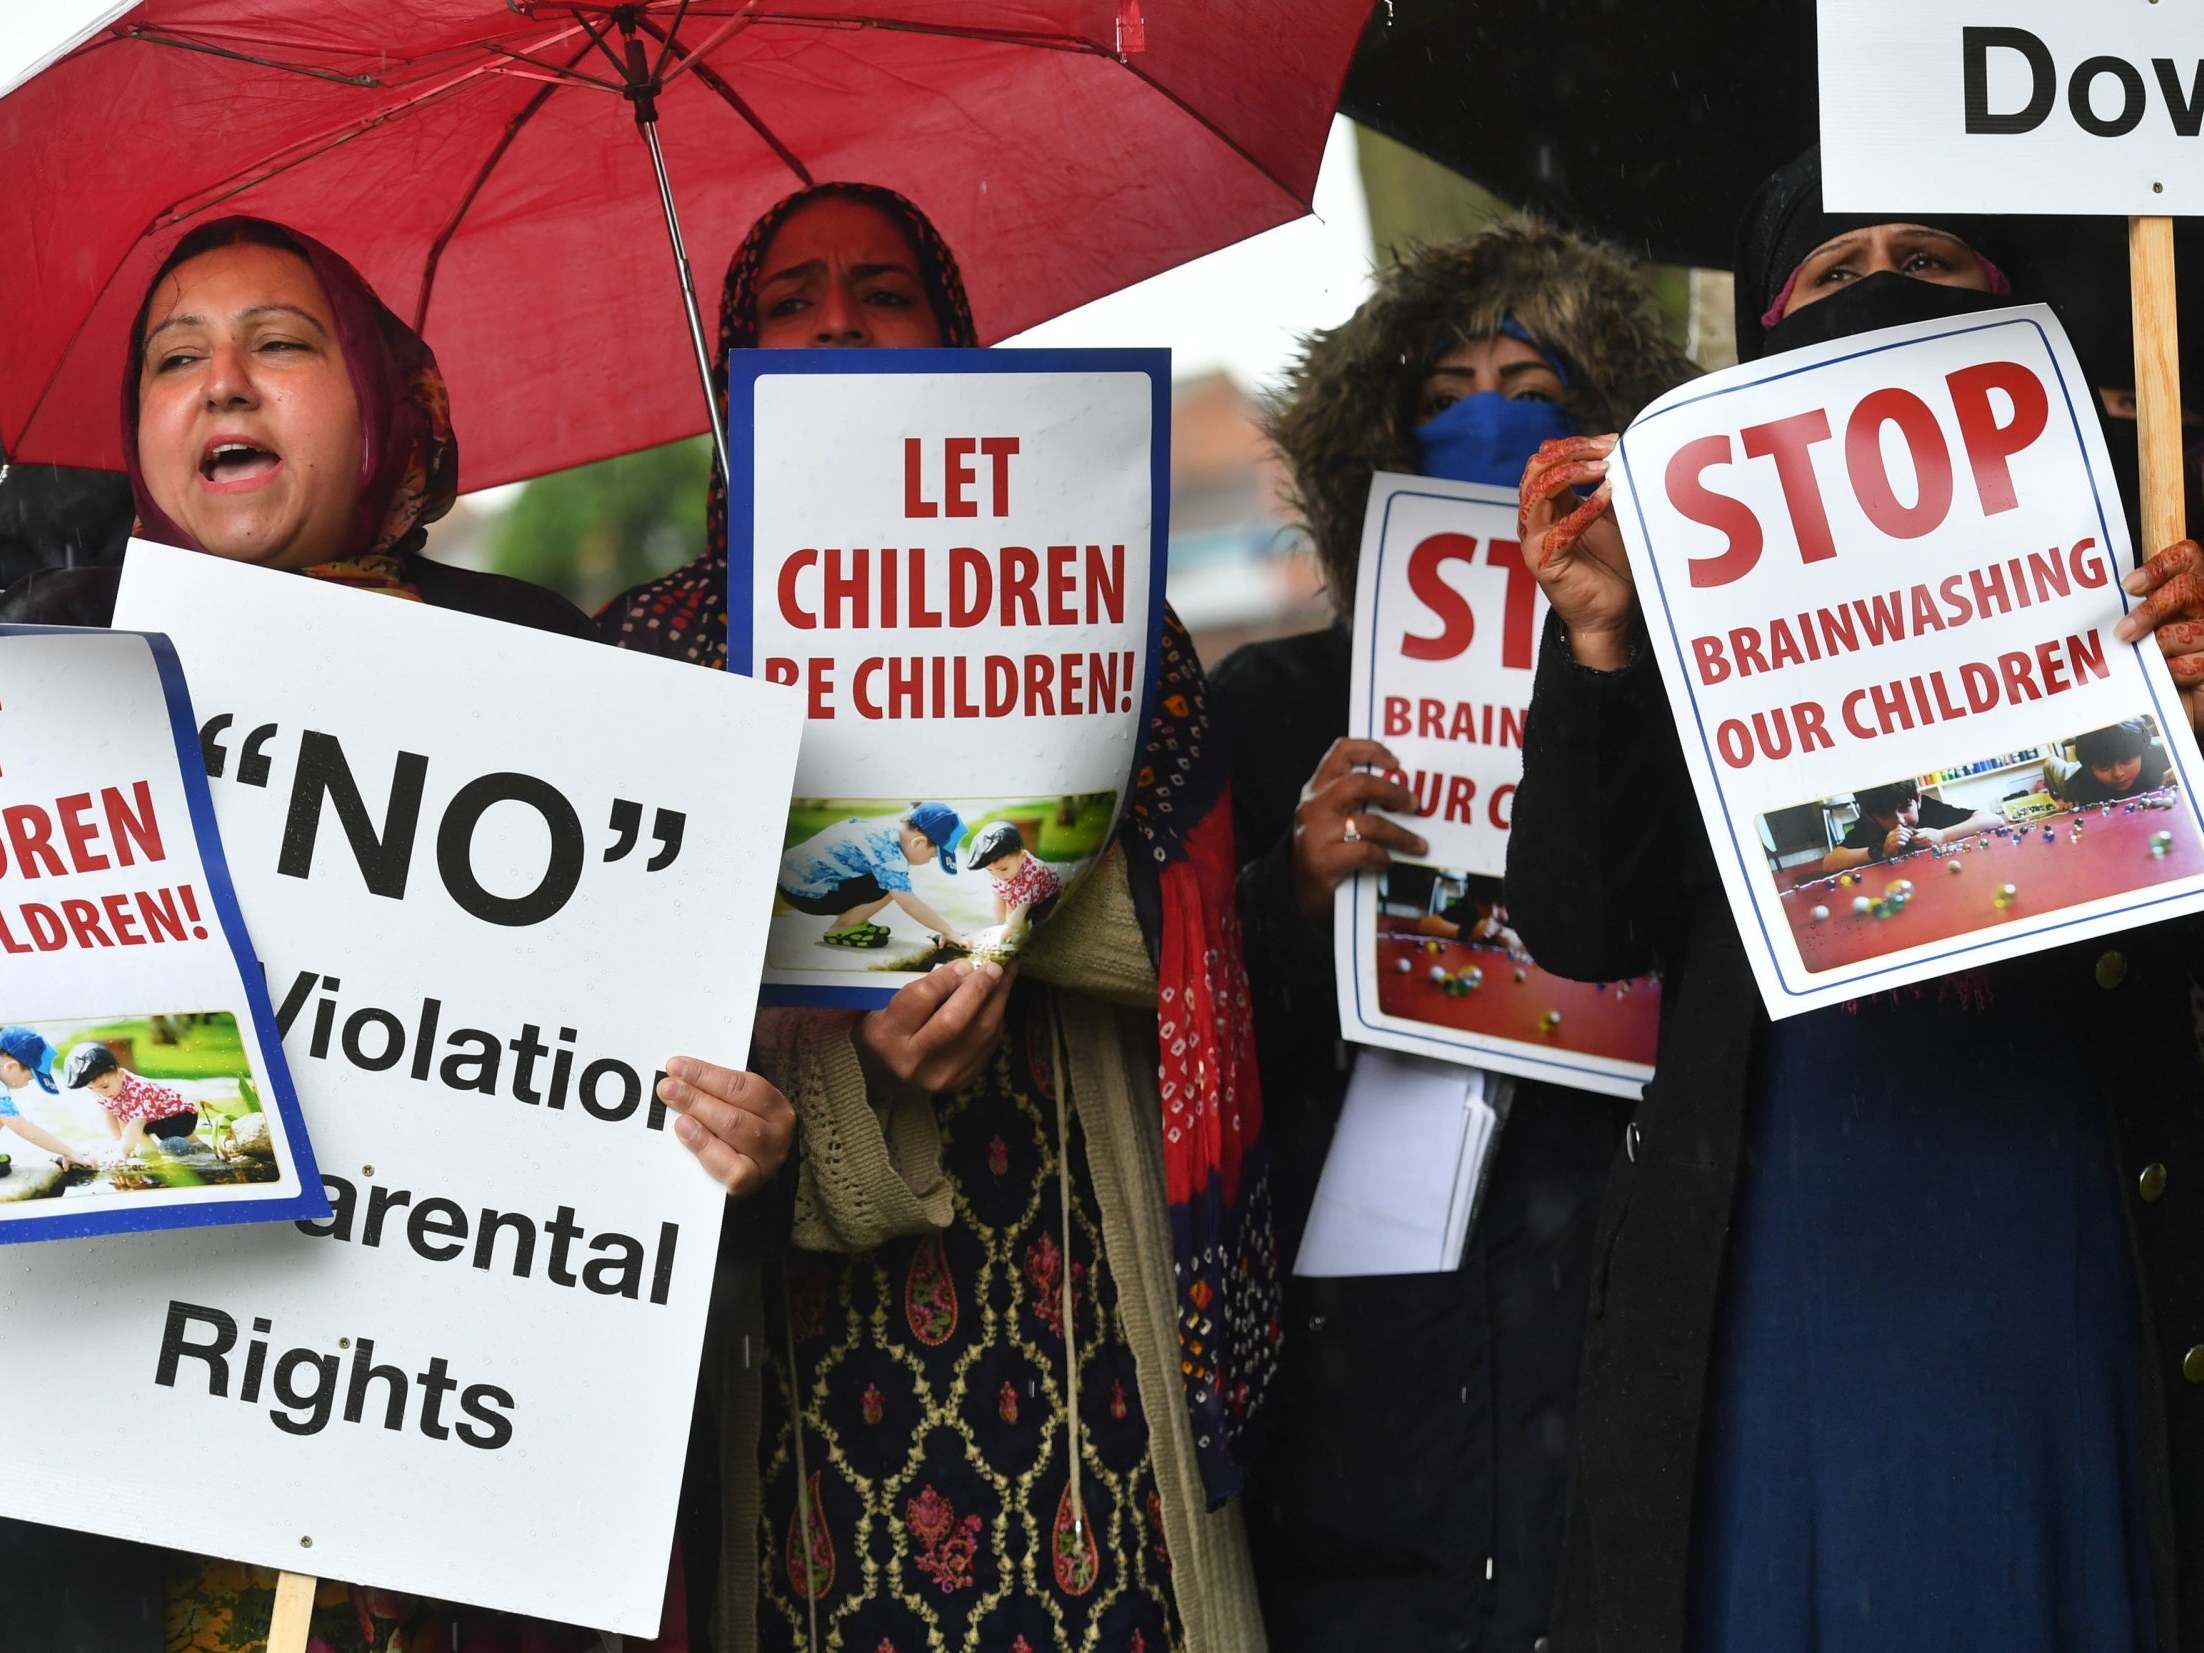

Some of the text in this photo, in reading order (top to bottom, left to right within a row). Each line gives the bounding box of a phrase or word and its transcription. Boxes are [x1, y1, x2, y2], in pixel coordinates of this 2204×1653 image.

[905, 437, 1020, 518] LET
[1664, 361, 2048, 588] STOP
[777, 545, 1125, 630] CHILDREN
[1691, 537, 2108, 686] BRAINWASHING
[852, 651, 1135, 720] CHILDREN!
[1716, 629, 2111, 769] OUR CHILDREN
[0, 780, 166, 880] REN
[294, 1173, 679, 1306] arental
[155, 1300, 515, 1450] Rights
